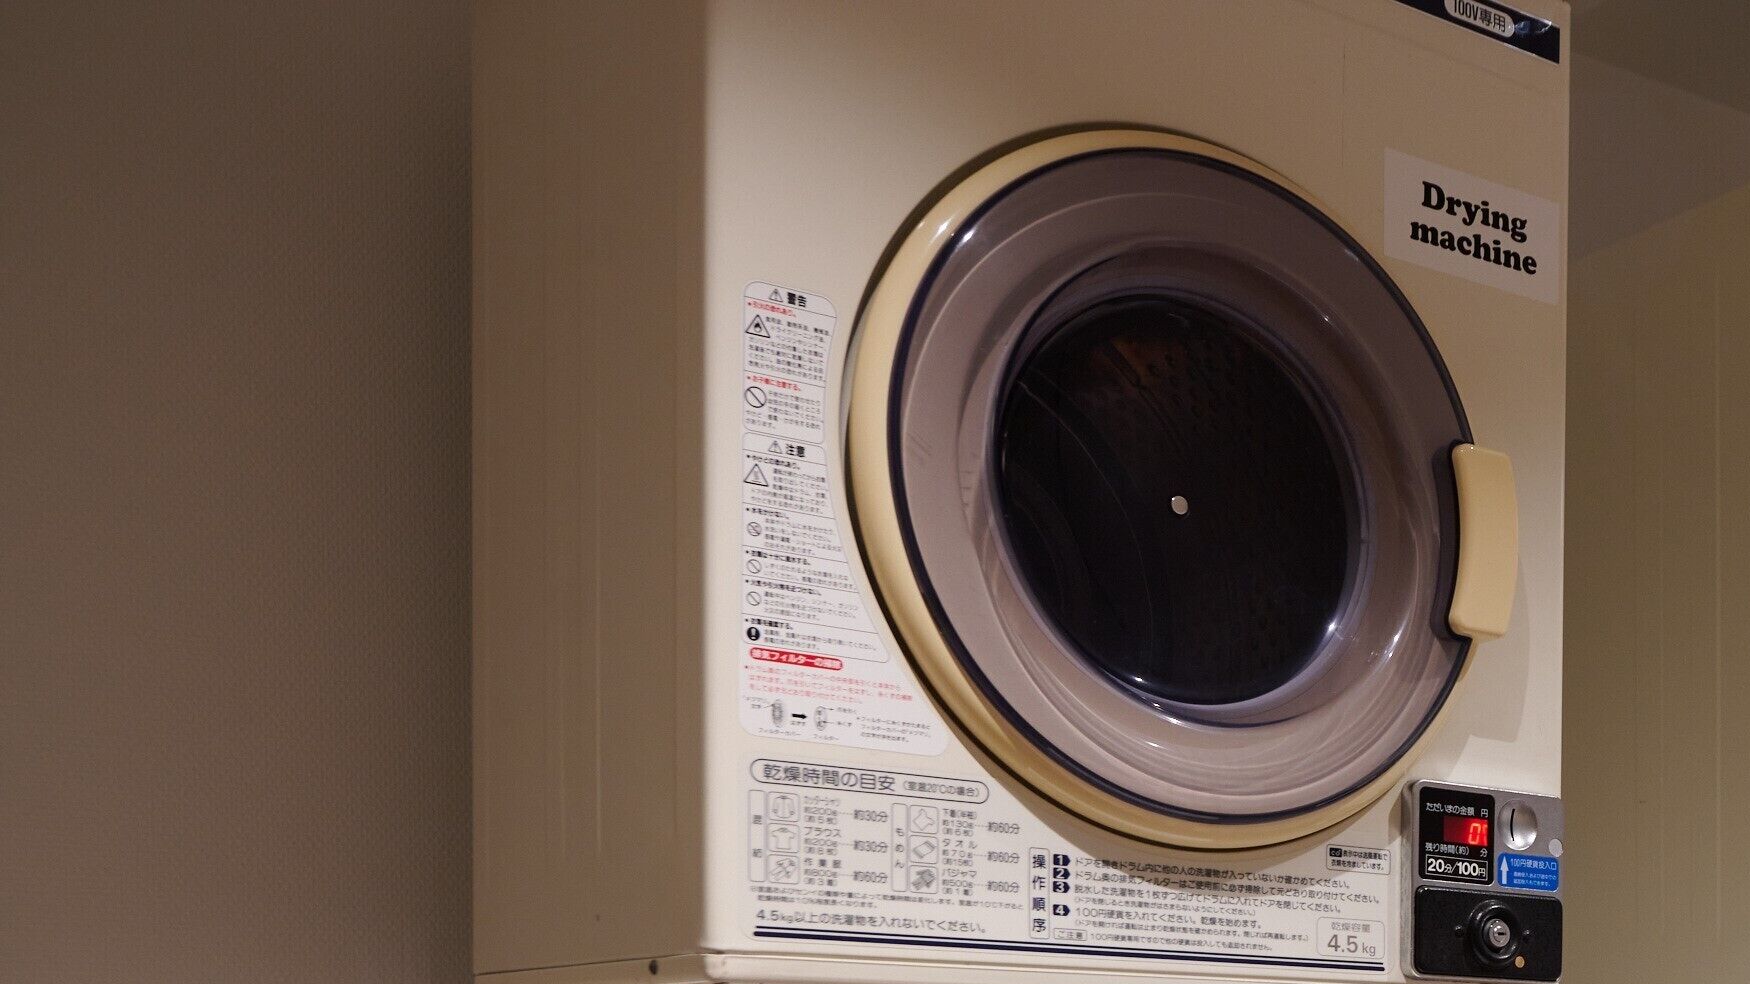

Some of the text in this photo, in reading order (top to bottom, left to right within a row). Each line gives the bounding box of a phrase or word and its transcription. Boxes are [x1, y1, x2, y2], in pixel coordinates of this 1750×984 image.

[1421, 180, 1528, 243] Drying
[1410, 221, 1538, 275] machine
[763, 764, 896, 792] 乾燥時間の目安
[1480, 808, 1489, 818] 円
[1468, 823, 1481, 845] 0
[1480, 847, 1488, 857] 分
[1056, 868, 1065, 879] 2
[1427, 858, 1486, 878] 20分/100円
[1032, 854, 1047, 934] 操作順序
[1055, 882, 1065, 892] 3
[1055, 905, 1066, 915] 4
[1327, 934, 1376, 957] 4.5 kg
